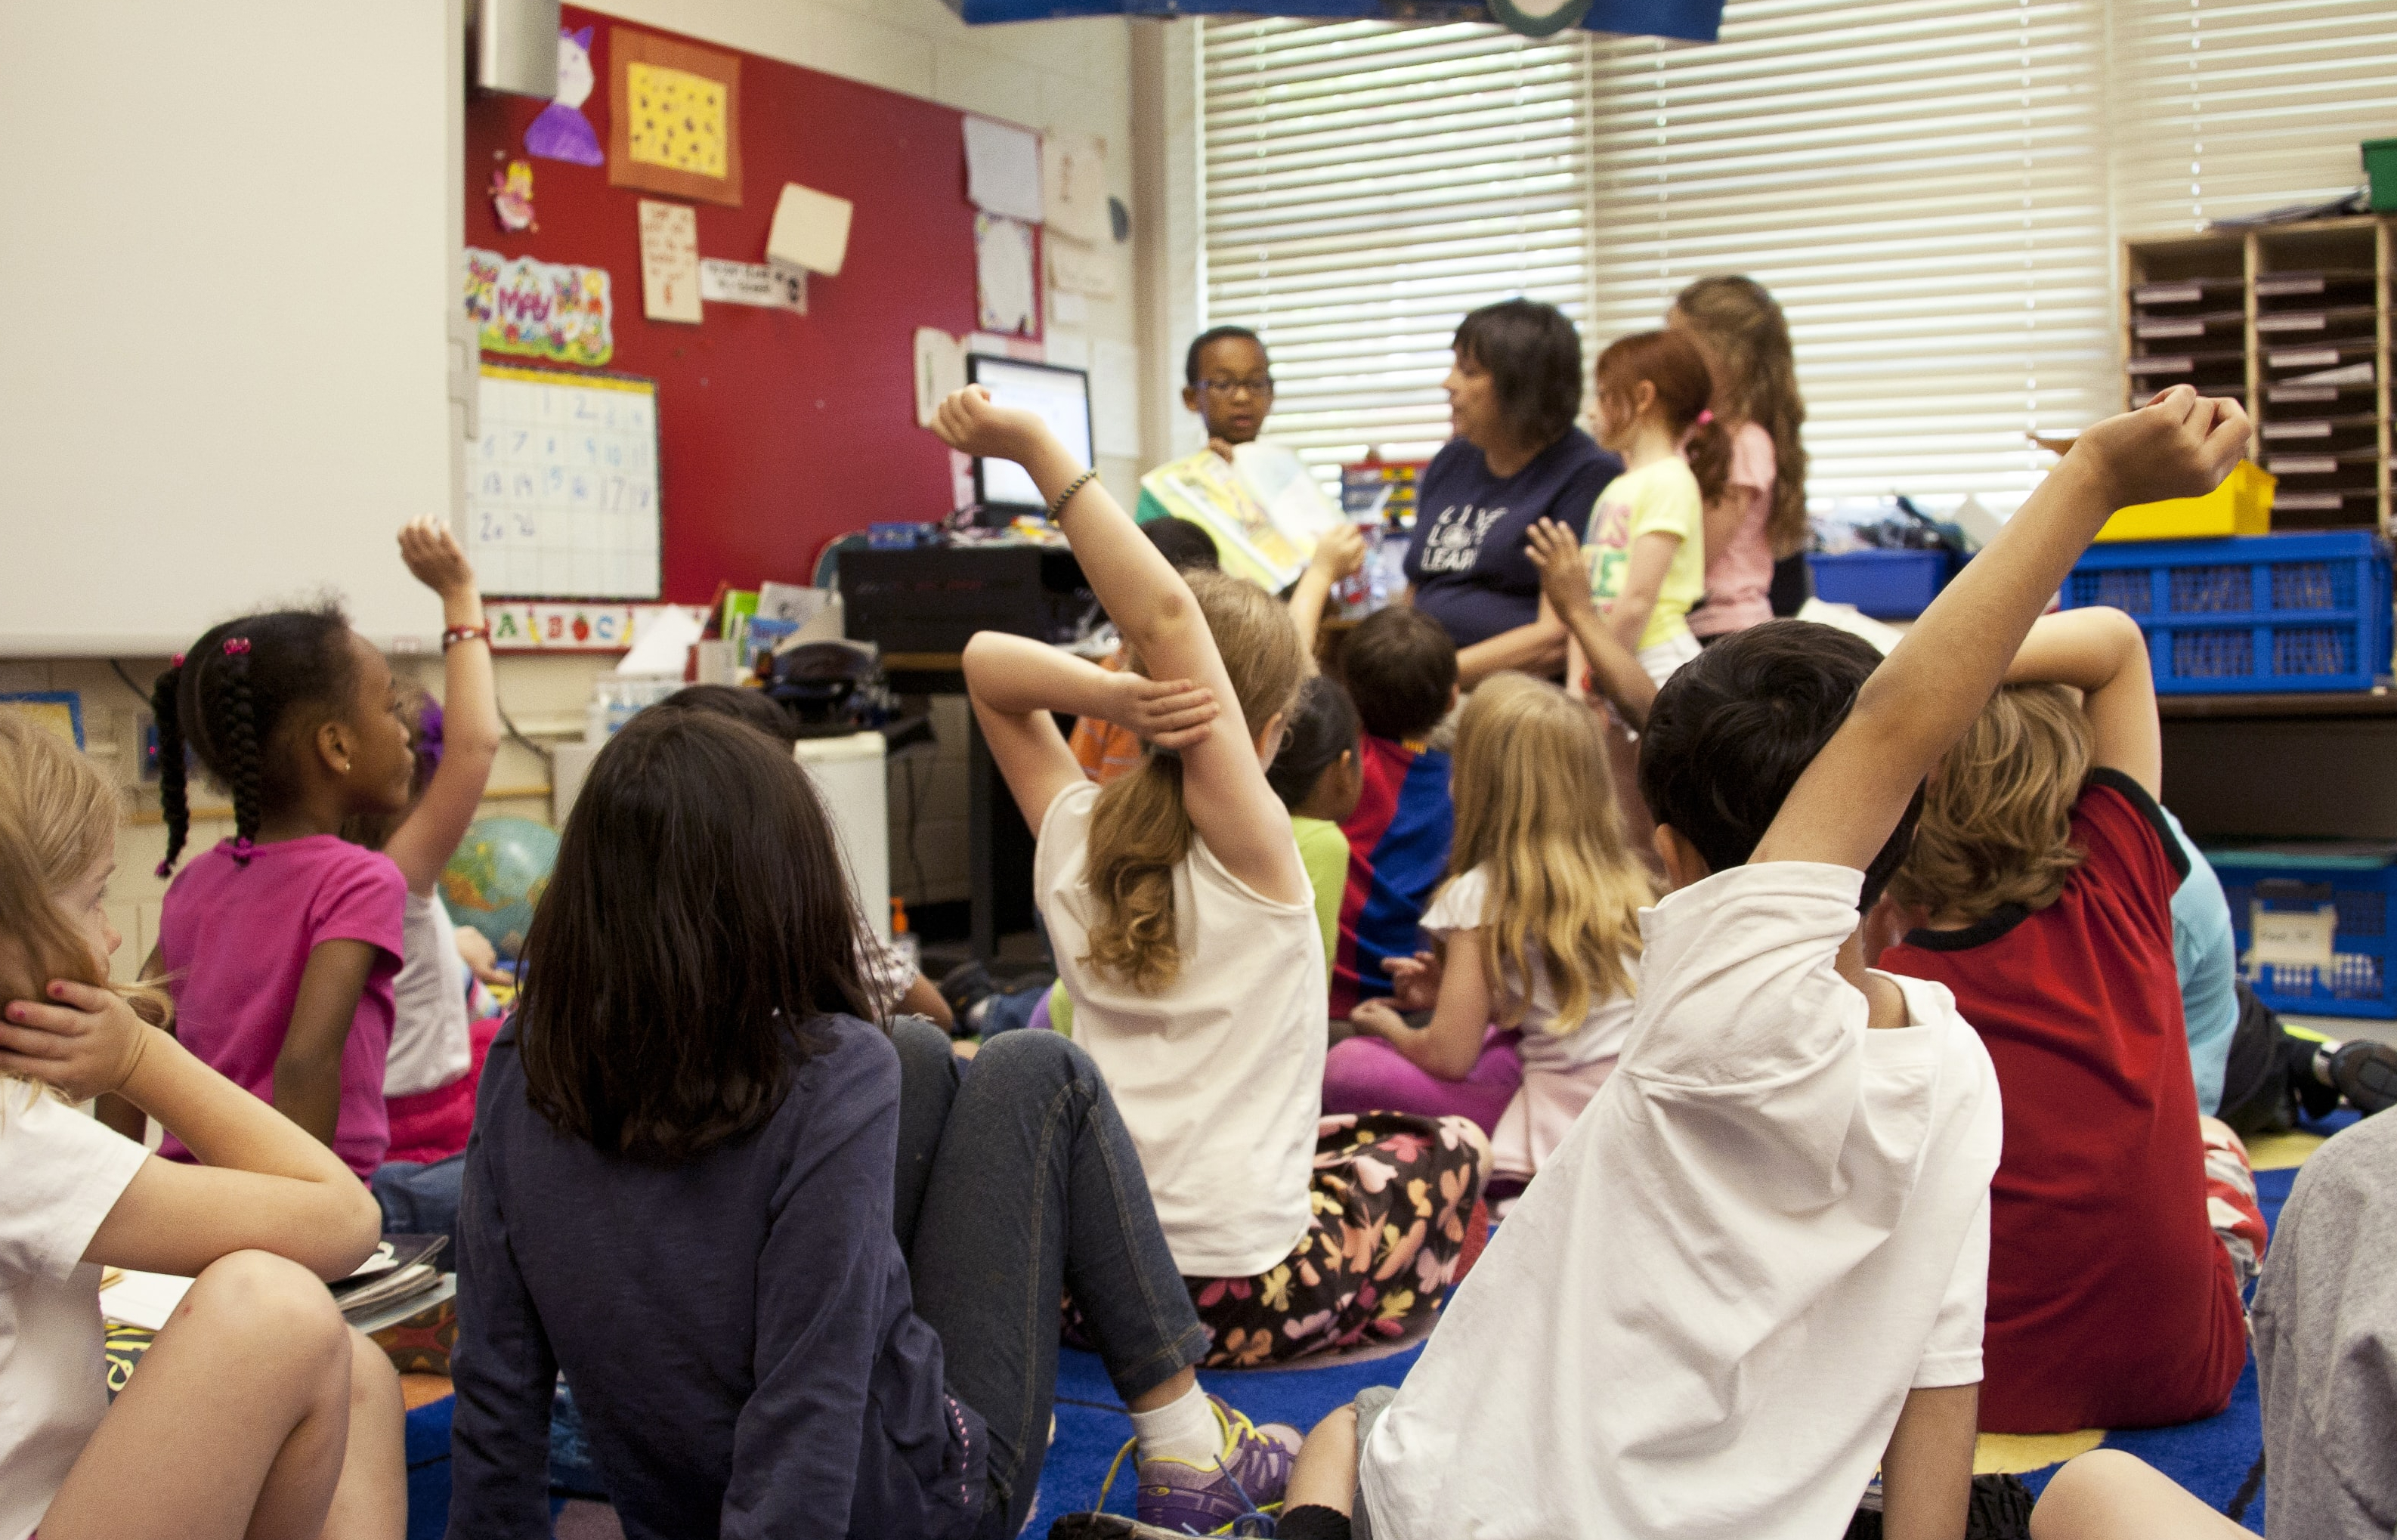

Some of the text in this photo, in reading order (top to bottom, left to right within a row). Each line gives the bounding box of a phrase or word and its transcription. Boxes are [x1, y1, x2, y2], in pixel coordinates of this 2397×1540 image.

[575, 393, 598, 419] 2
[514, 431, 528, 453] 7
[600, 475, 626, 512] 17
[496, 612, 614, 639] A B C
